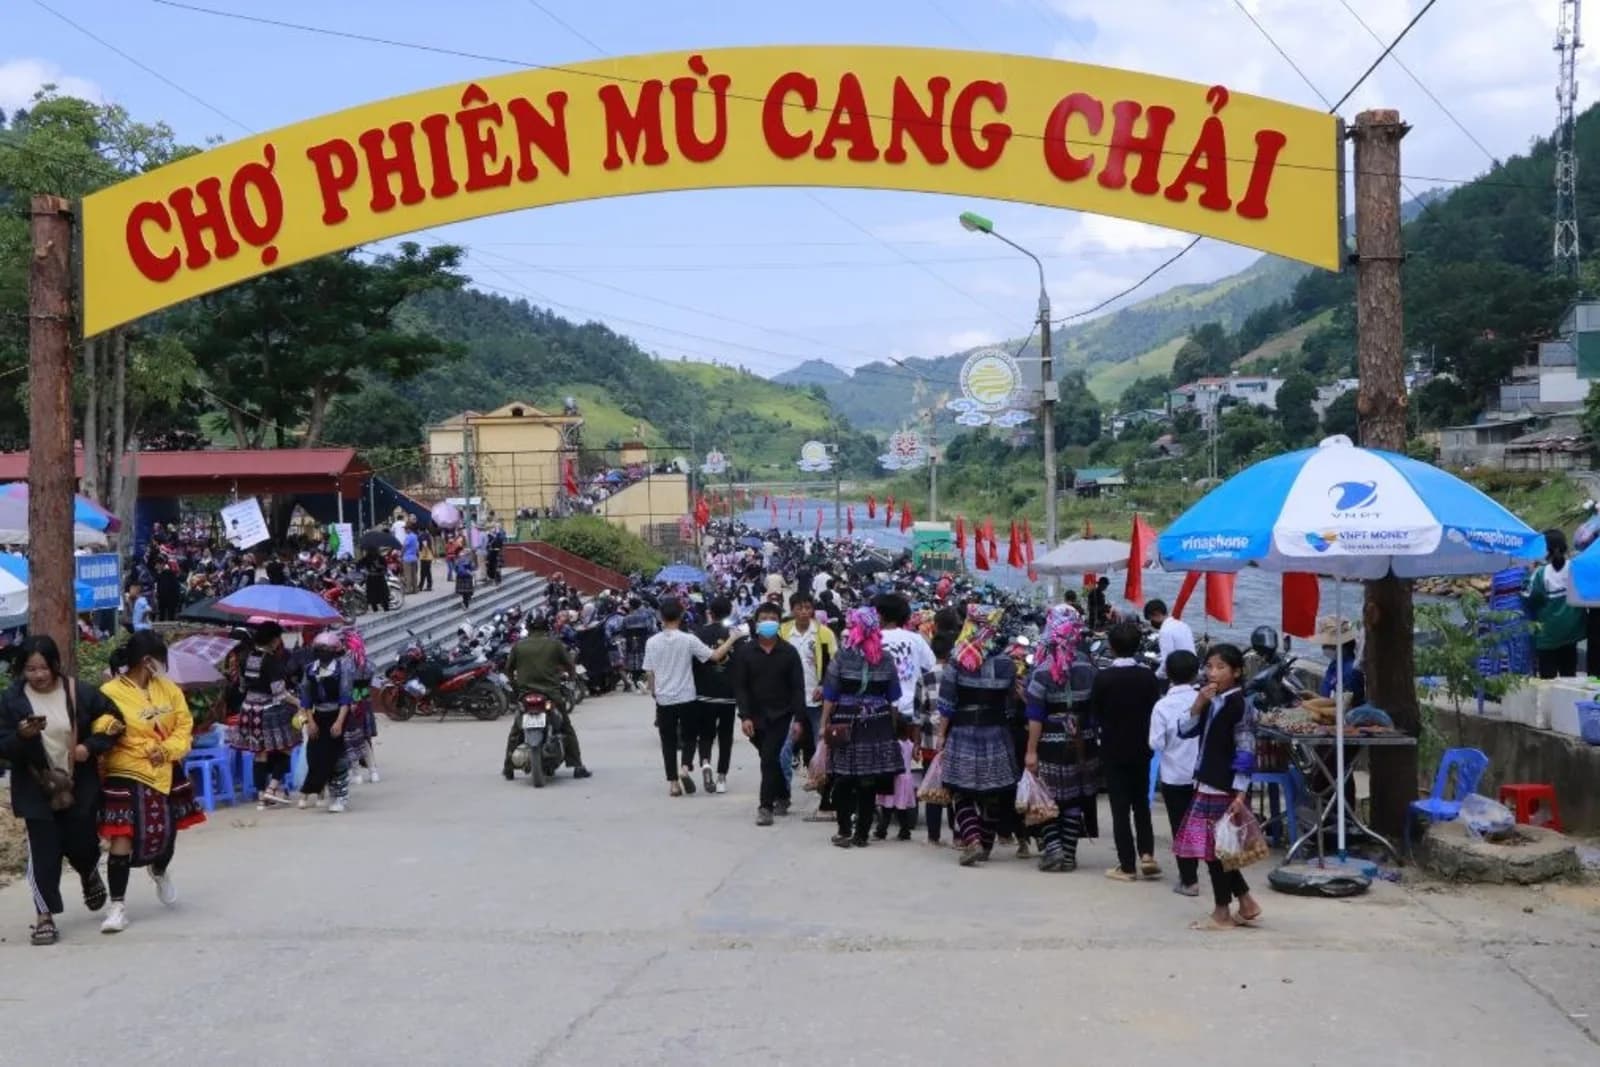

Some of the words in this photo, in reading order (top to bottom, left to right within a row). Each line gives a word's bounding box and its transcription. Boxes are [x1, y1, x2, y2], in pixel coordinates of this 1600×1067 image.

[125, 142, 285, 283] CHỢ
[305, 83, 571, 226] PHIÊN
[598, 54, 731, 172] MÙ
[761, 71, 1012, 169] CANG
[1043, 85, 1288, 220] CHẢI
[1340, 530, 1367, 540] VNPT
[1371, 530, 1409, 540] MONEY
